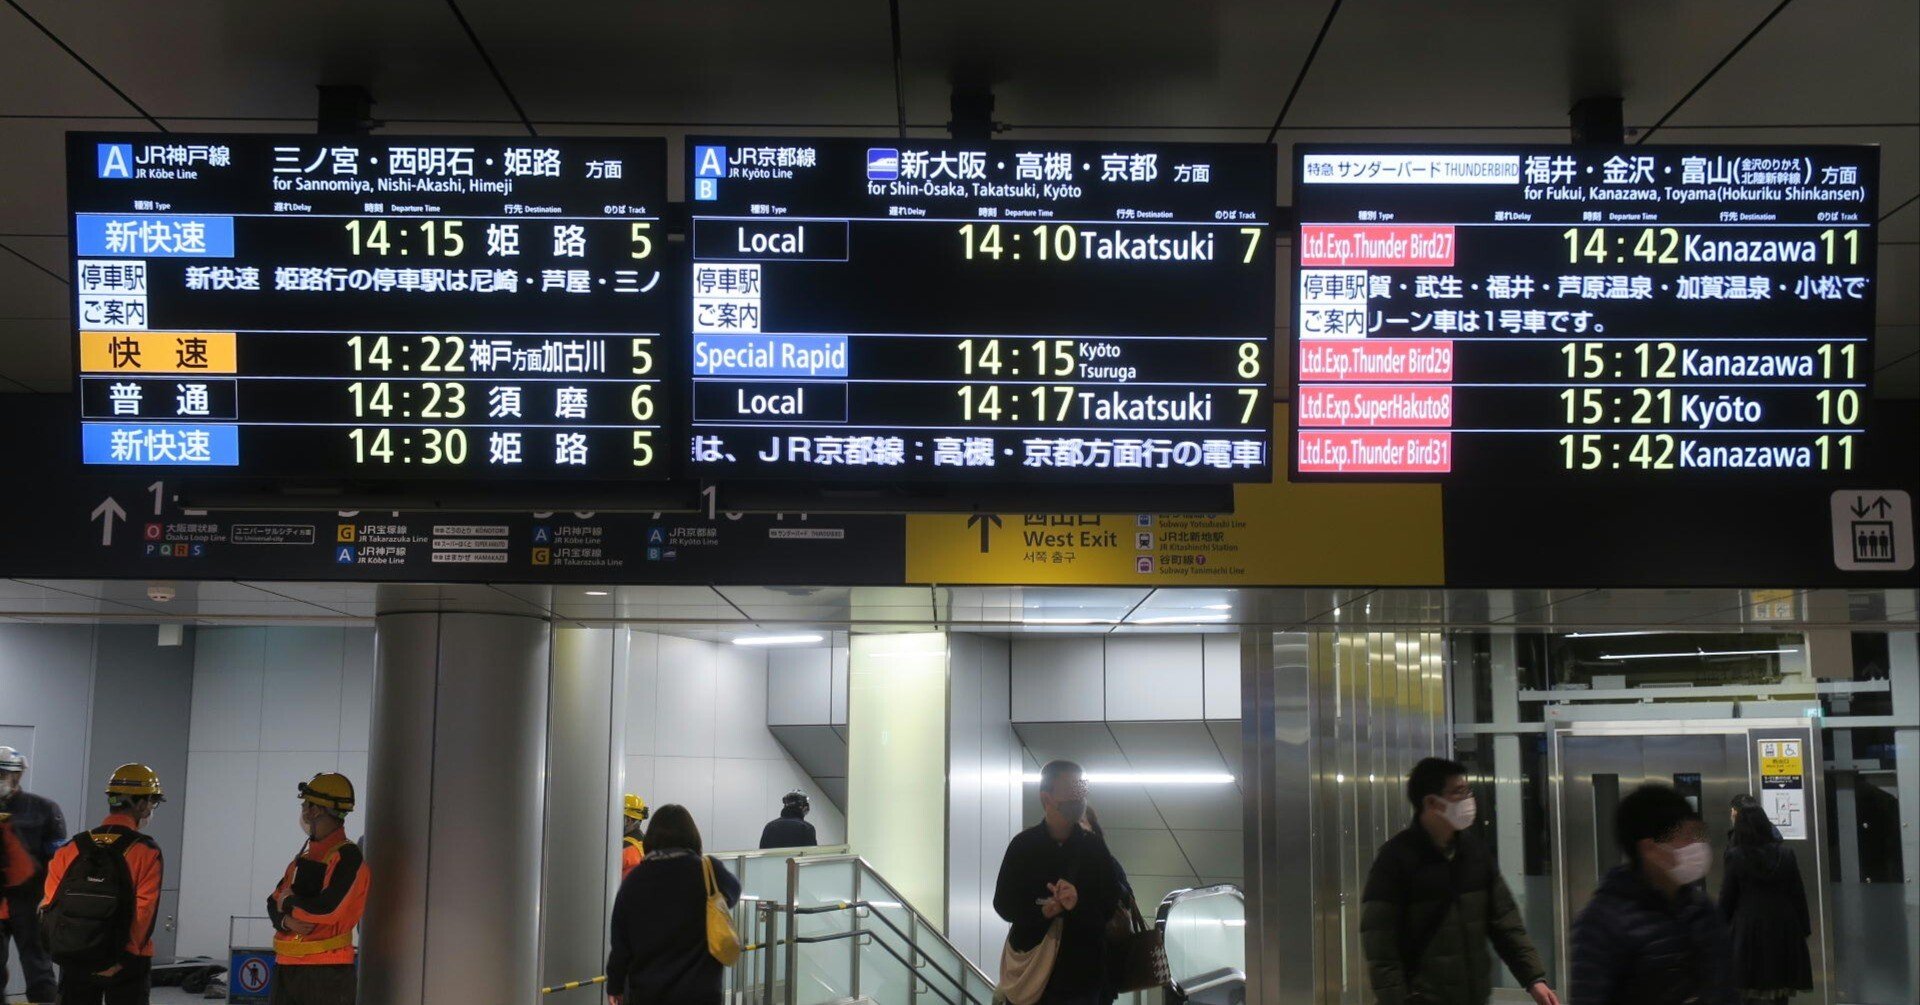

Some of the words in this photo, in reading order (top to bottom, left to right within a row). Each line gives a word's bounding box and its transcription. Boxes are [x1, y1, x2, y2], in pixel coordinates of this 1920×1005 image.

[102, 145, 129, 177] A
[135, 145, 231, 167] JR神戸線
[273, 147, 561, 178] 三ノ宮・西明石・姫路
[585, 160, 623, 179] 方面
[700, 148, 721, 176] A
[729, 147, 816, 168] JR京都線
[135, 168, 146, 179] JR
[149, 167, 174, 180] Kōbe
[176, 168, 197, 180] Line
[729, 168, 740, 179] JR
[742, 168, 771, 180] Kyōto
[773, 169, 793, 179] Line
[901, 150, 1158, 182] 新大阪・高槻・京都
[1173, 164, 1210, 183] 方面
[1307, 162, 1334, 177] 特急
[1337, 161, 1441, 178] サンダーバード
[1444, 162, 1519, 178] THUNDERBIRD
[1821, 166, 1858, 185] 方面
[273, 177, 293, 191] for
[296, 178, 374, 194] Sannomiya,
[378, 178, 466, 194] Nishi-Akashi,
[470, 178, 513, 196] Himeji
[700, 181, 713, 198] B
[868, 181, 886, 195] for
[890, 180, 968, 198] Shin-Ōsaka,
[972, 183, 1039, 199] Takatsuki,
[1043, 183, 1081, 201] Kyōto
[1524, 186, 1543, 200] for
[1546, 187, 1586, 203] Fukui,
[1589, 187, 1661, 203] Kanazawa,
[1785, 186, 1865, 203] Shinkansen)
[155, 201, 171, 211] Type
[293, 202, 312, 213] Delay
[391, 204, 423, 214] Departure
[424, 204, 441, 213] Time
[504, 204, 523, 214] 行先
[525, 205, 562, 214] Destination
[629, 206, 646, 214] Track
[771, 205, 787, 215] Type
[907, 207, 926, 217] Delay
[1005, 208, 1037, 218] Departure
[1038, 208, 1054, 217] Time
[1116, 209, 1135, 219] 行先
[1137, 210, 1173, 219] Destination
[1239, 211, 1256, 220] Track
[1378, 211, 1394, 221] Type
[1513, 212, 1531, 222] Delay
[1609, 212, 1641, 222] Departure
[1642, 212, 1657, 221] Time
[1720, 211, 1738, 222] 行先
[1740, 213, 1776, 221] Destination
[1841, 212, 1858, 221] Track
[105, 220, 206, 254] 新快速
[344, 219, 464, 258] 14:15
[631, 222, 652, 259] 5
[738, 226, 804, 253] Local
[958, 223, 1077, 261] 14:10
[1080, 230, 1214, 261] Takatsuki
[1240, 227, 1261, 264] 7
[1410, 233, 1453, 260] Bird27
[1563, 227, 1679, 264] 14:42
[1684, 234, 1816, 263] Kanazawa
[1819, 228, 1859, 265] 11
[81, 264, 145, 291] 停車駅
[185, 266, 261, 291] 新快速
[696, 268, 759, 294] 停車駅
[1303, 274, 1364, 300] 停車駅
[84, 299, 145, 326] ご案内
[698, 302, 758, 329] ご案内
[1304, 309, 1364, 335] ご案内
[347, 335, 465, 371] 14:22
[470, 339, 606, 373] 神戸方面加古川
[632, 338, 652, 375] 5
[696, 341, 773, 375] Special
[781, 342, 845, 376] Rapid
[957, 339, 1074, 376] 14:15
[1238, 342, 1260, 379] 8
[1079, 342, 1121, 361] Kyōto
[1409, 348, 1450, 374] Bird29
[1561, 342, 1676, 379] 15:12
[1682, 348, 1813, 376] Kanazawa
[1817, 343, 1855, 379] 11
[1079, 363, 1137, 382] Tsuruga
[348, 382, 466, 418] 14:23
[631, 384, 654, 421] 6
[738, 387, 804, 415] Local
[957, 385, 1074, 422] 14:17
[1078, 391, 1211, 421] Takatsuki
[1238, 388, 1259, 424] 7
[1560, 388, 1672, 425] 15:21
[1681, 394, 1761, 429] Kyōto
[1815, 389, 1859, 425] 10
[110, 429, 211, 462] 新快速
[348, 428, 467, 465] 14:30
[632, 430, 653, 467] 5
[1406, 440, 1449, 466] Bird31
[1559, 434, 1674, 470] 15:42
[1679, 440, 1811, 468] Kanazawa
[1814, 435, 1852, 471] 11
[1231, 520, 1247, 528] Line
[340, 527, 352, 540] G
[358, 535, 368, 543] JR
[369, 535, 411, 543] Takarazuka
[412, 535, 428, 543] Line
[536, 528, 547, 542] A
[650, 529, 662, 542] A
[1023, 530, 1074, 547] West
[1080, 530, 1118, 547] Exit
[338, 549, 351, 561] A
[357, 556, 366, 564] JR
[535, 551, 547, 563] G
[1023, 551, 1048, 563] 서쪽
[1051, 551, 1076, 563] 출구
[1229, 567, 1246, 575] Line
